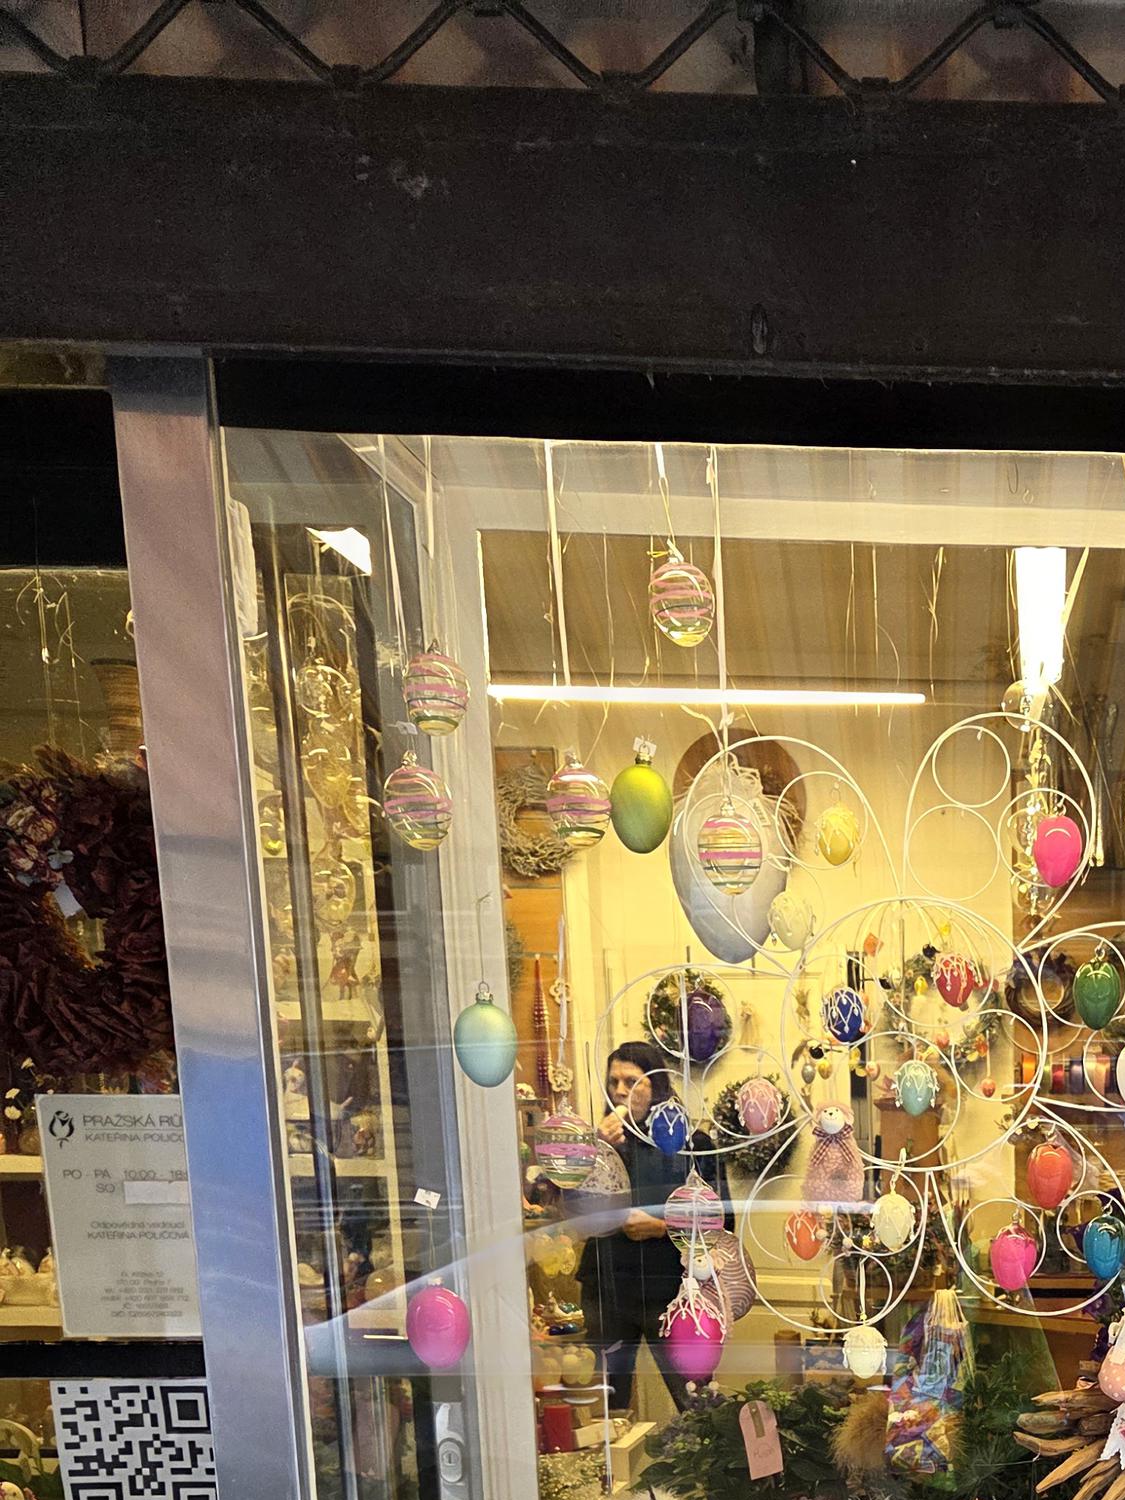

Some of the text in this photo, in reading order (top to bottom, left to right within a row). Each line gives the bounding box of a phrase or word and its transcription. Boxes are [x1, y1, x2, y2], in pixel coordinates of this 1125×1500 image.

[83, 1113, 183, 1128] PRAŽSKÁ RŮ
[143, 1132, 185, 1143] POLIČO
[62, 1169, 82, 1180] PO
[96, 1183, 116, 1193] SO
